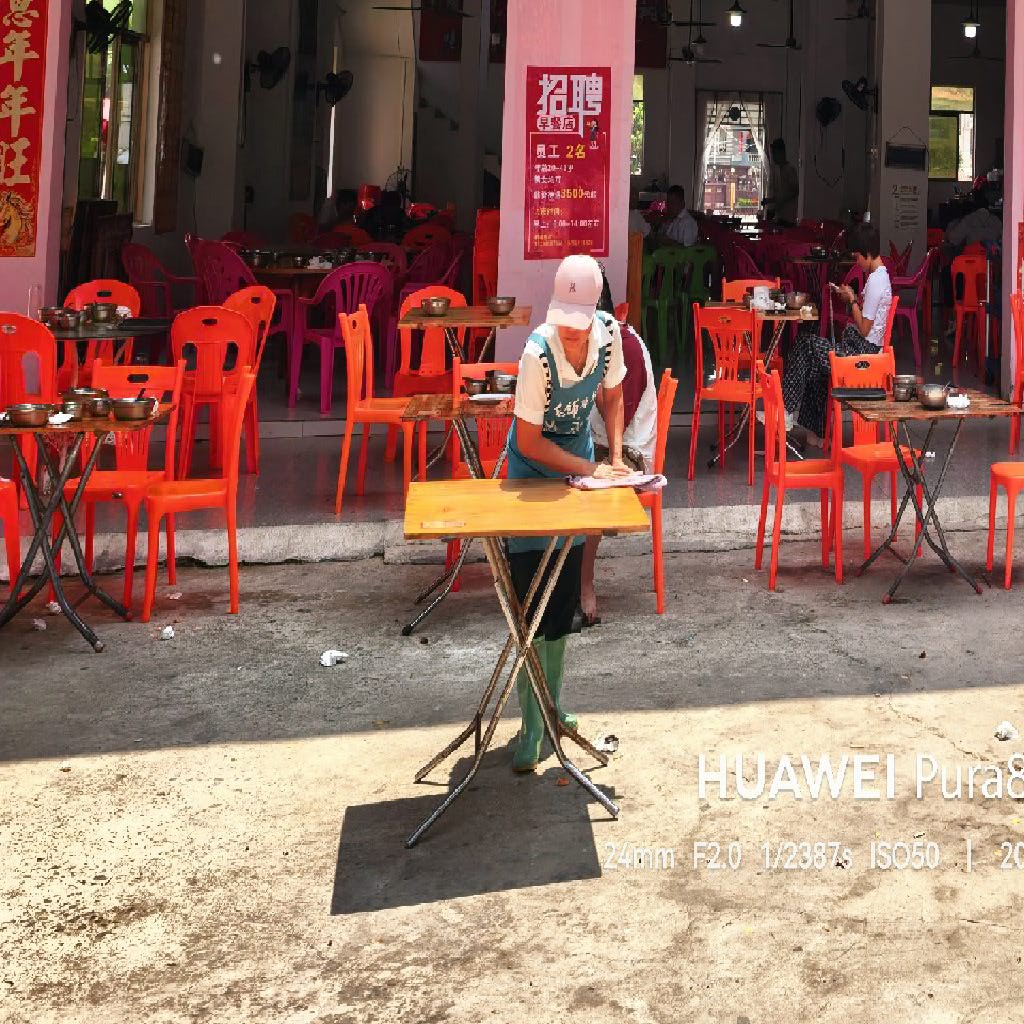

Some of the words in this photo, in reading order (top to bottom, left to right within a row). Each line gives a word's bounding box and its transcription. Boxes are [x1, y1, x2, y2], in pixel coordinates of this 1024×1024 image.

[537, 72, 604, 138] 招聘
[537, 144, 560, 159] 员工
[566, 144, 586, 159] 2名
